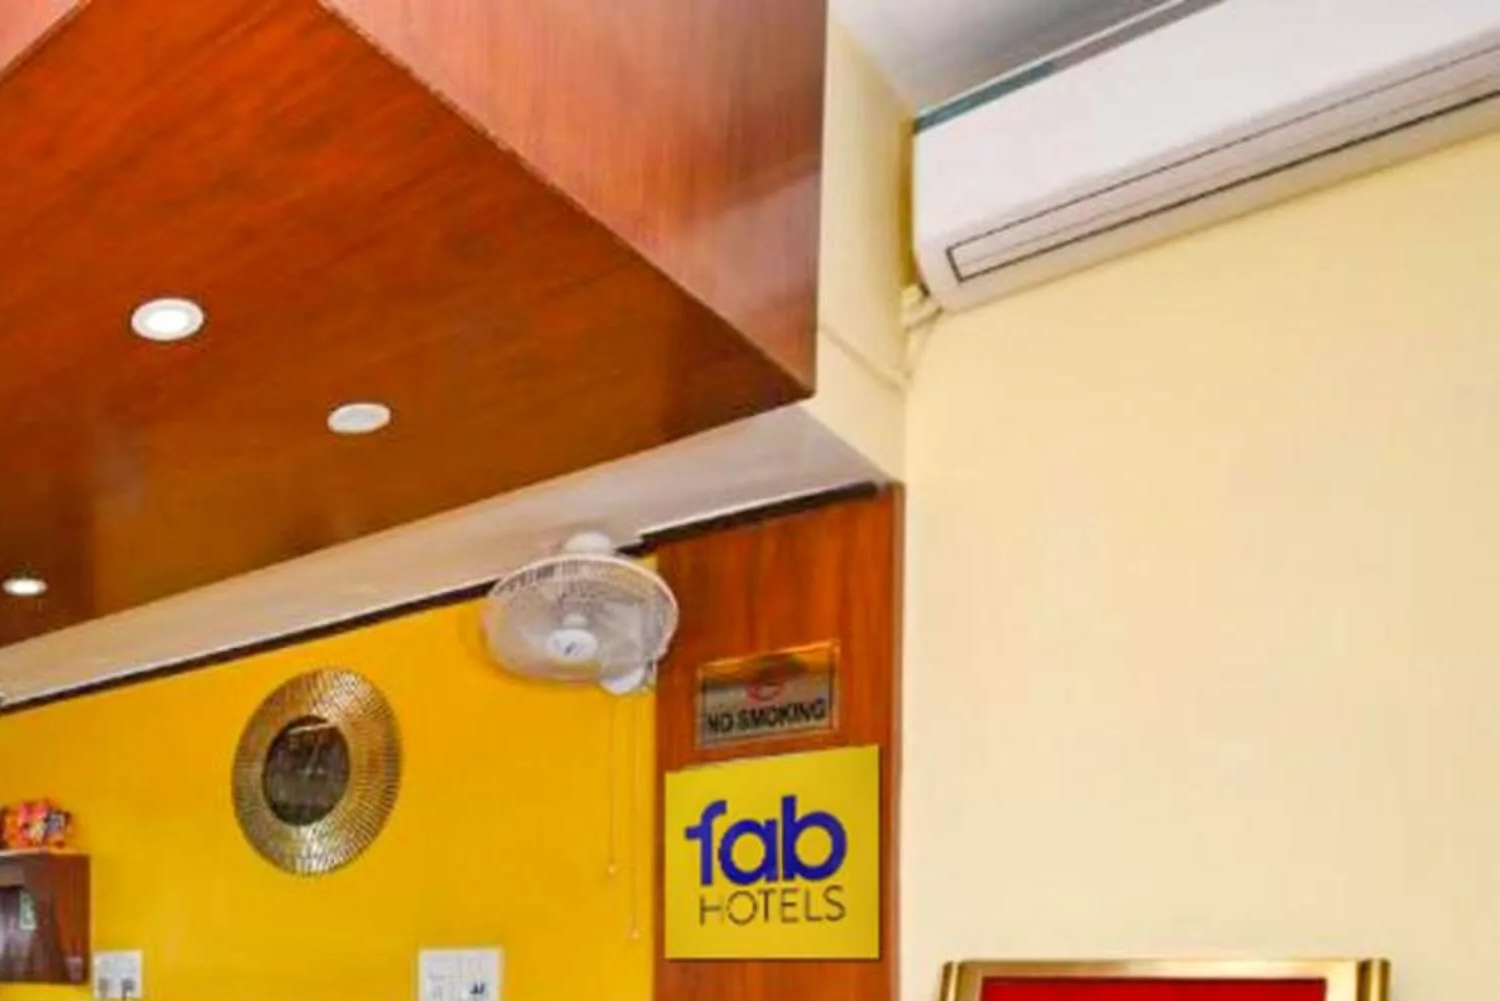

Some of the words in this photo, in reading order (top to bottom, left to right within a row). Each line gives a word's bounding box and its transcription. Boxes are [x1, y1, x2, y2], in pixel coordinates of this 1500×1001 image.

[707, 711, 734, 733] NO
[737, 698, 826, 730] SMOKING
[684, 795, 848, 886] fab
[699, 885, 846, 925] HOTELS
